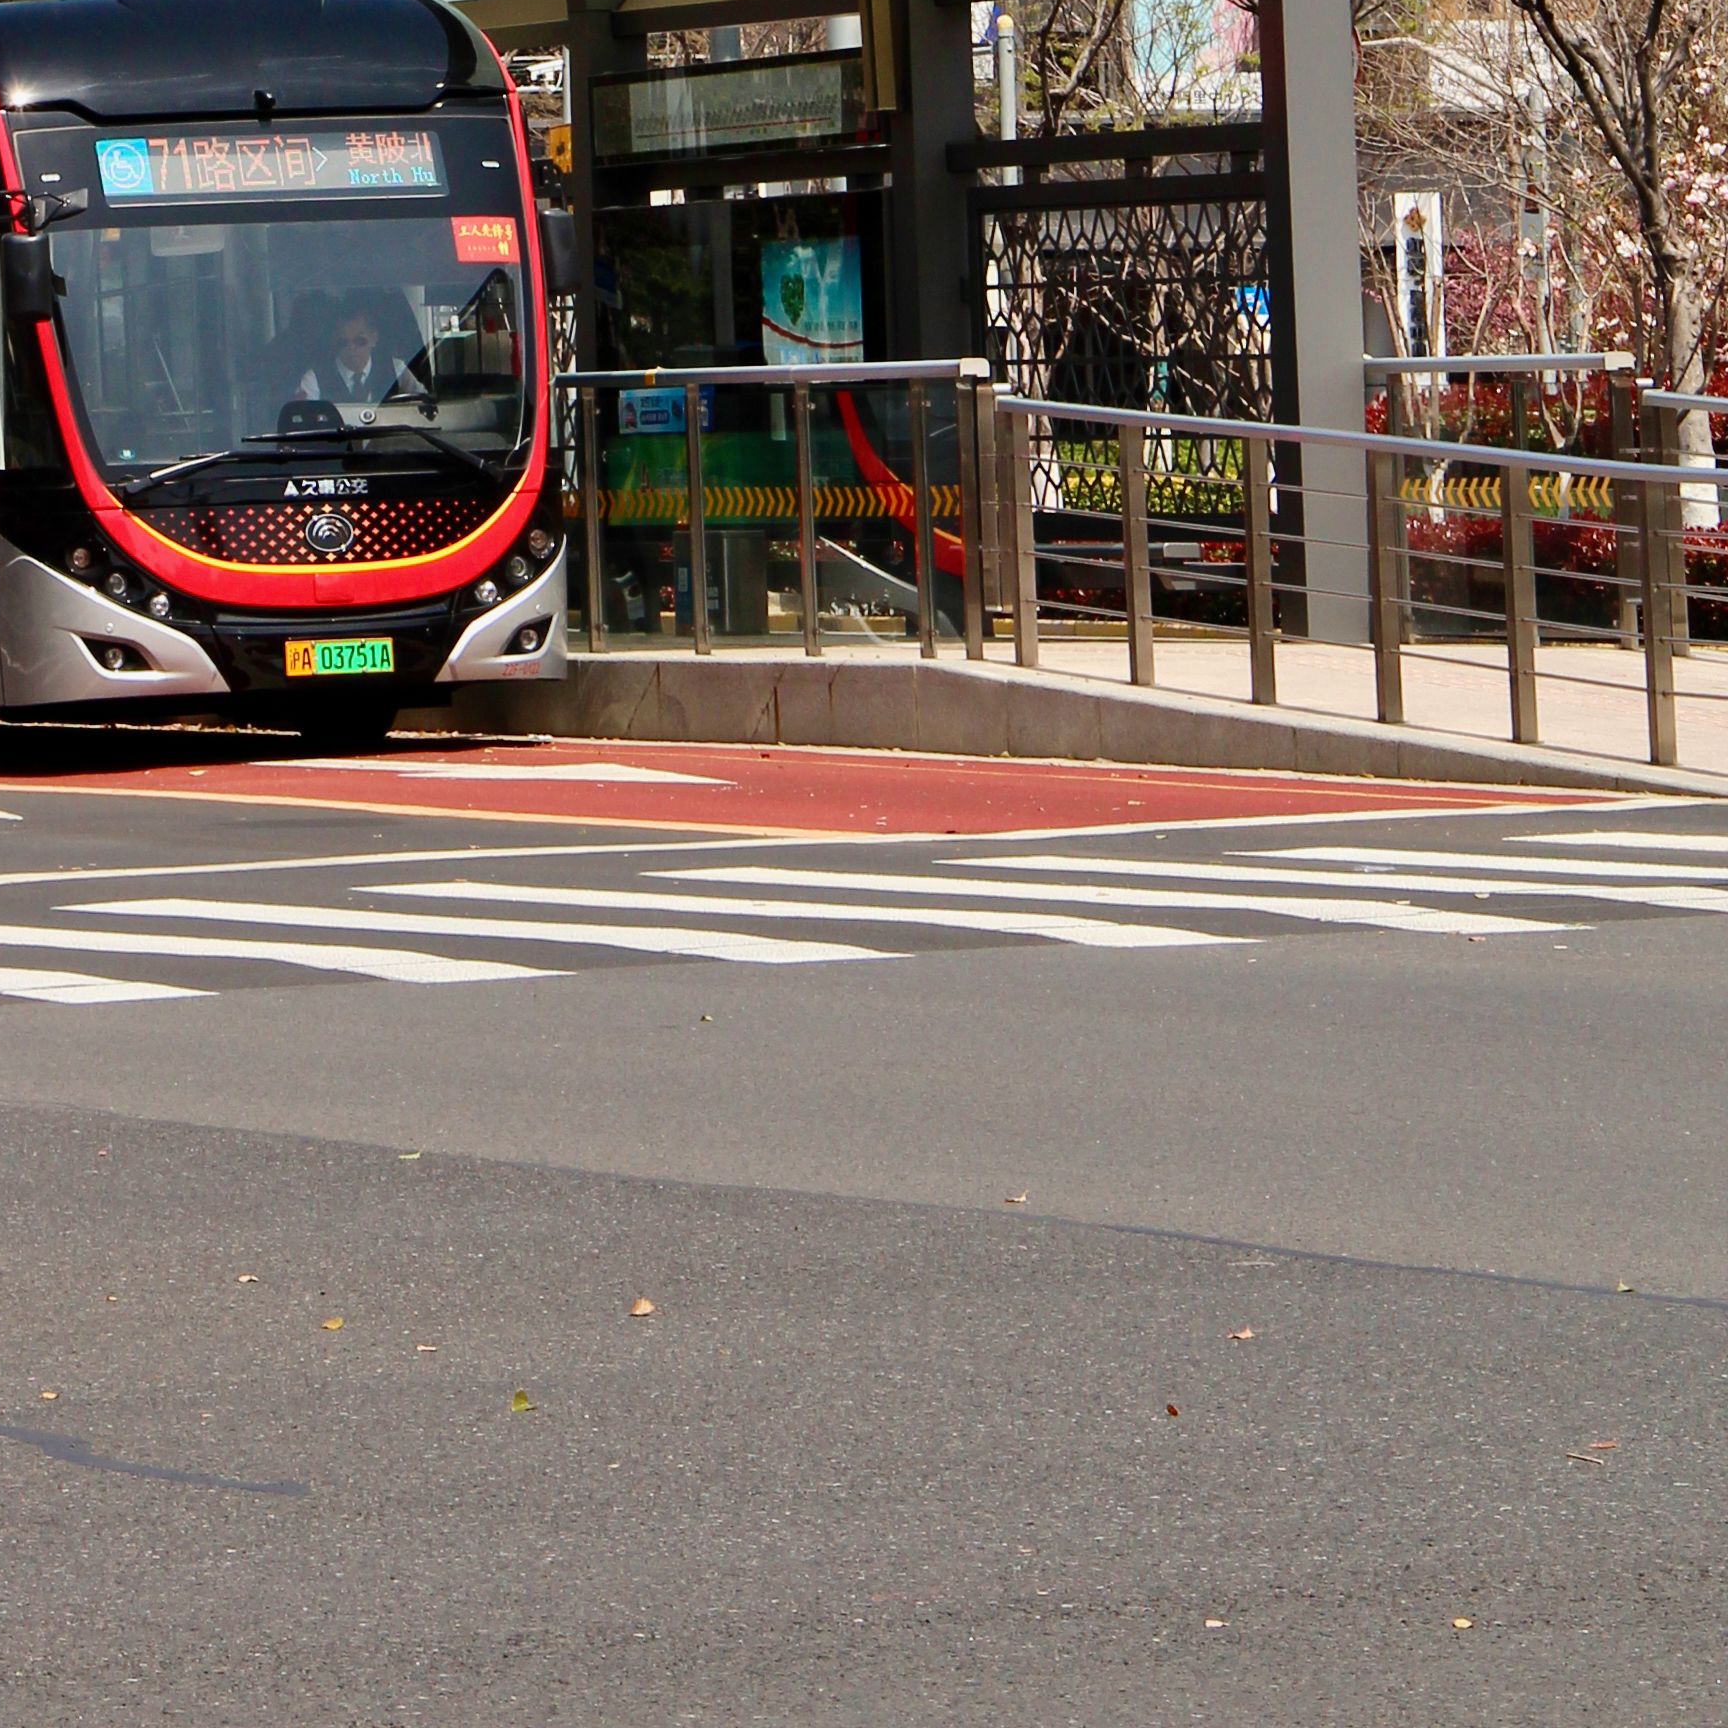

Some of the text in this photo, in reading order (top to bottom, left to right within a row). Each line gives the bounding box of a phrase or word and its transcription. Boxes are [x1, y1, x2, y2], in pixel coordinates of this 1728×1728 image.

[147, 136, 317, 191] 71路区间
[348, 167, 403, 186] North
[320, 644, 391, 670] 03751A
